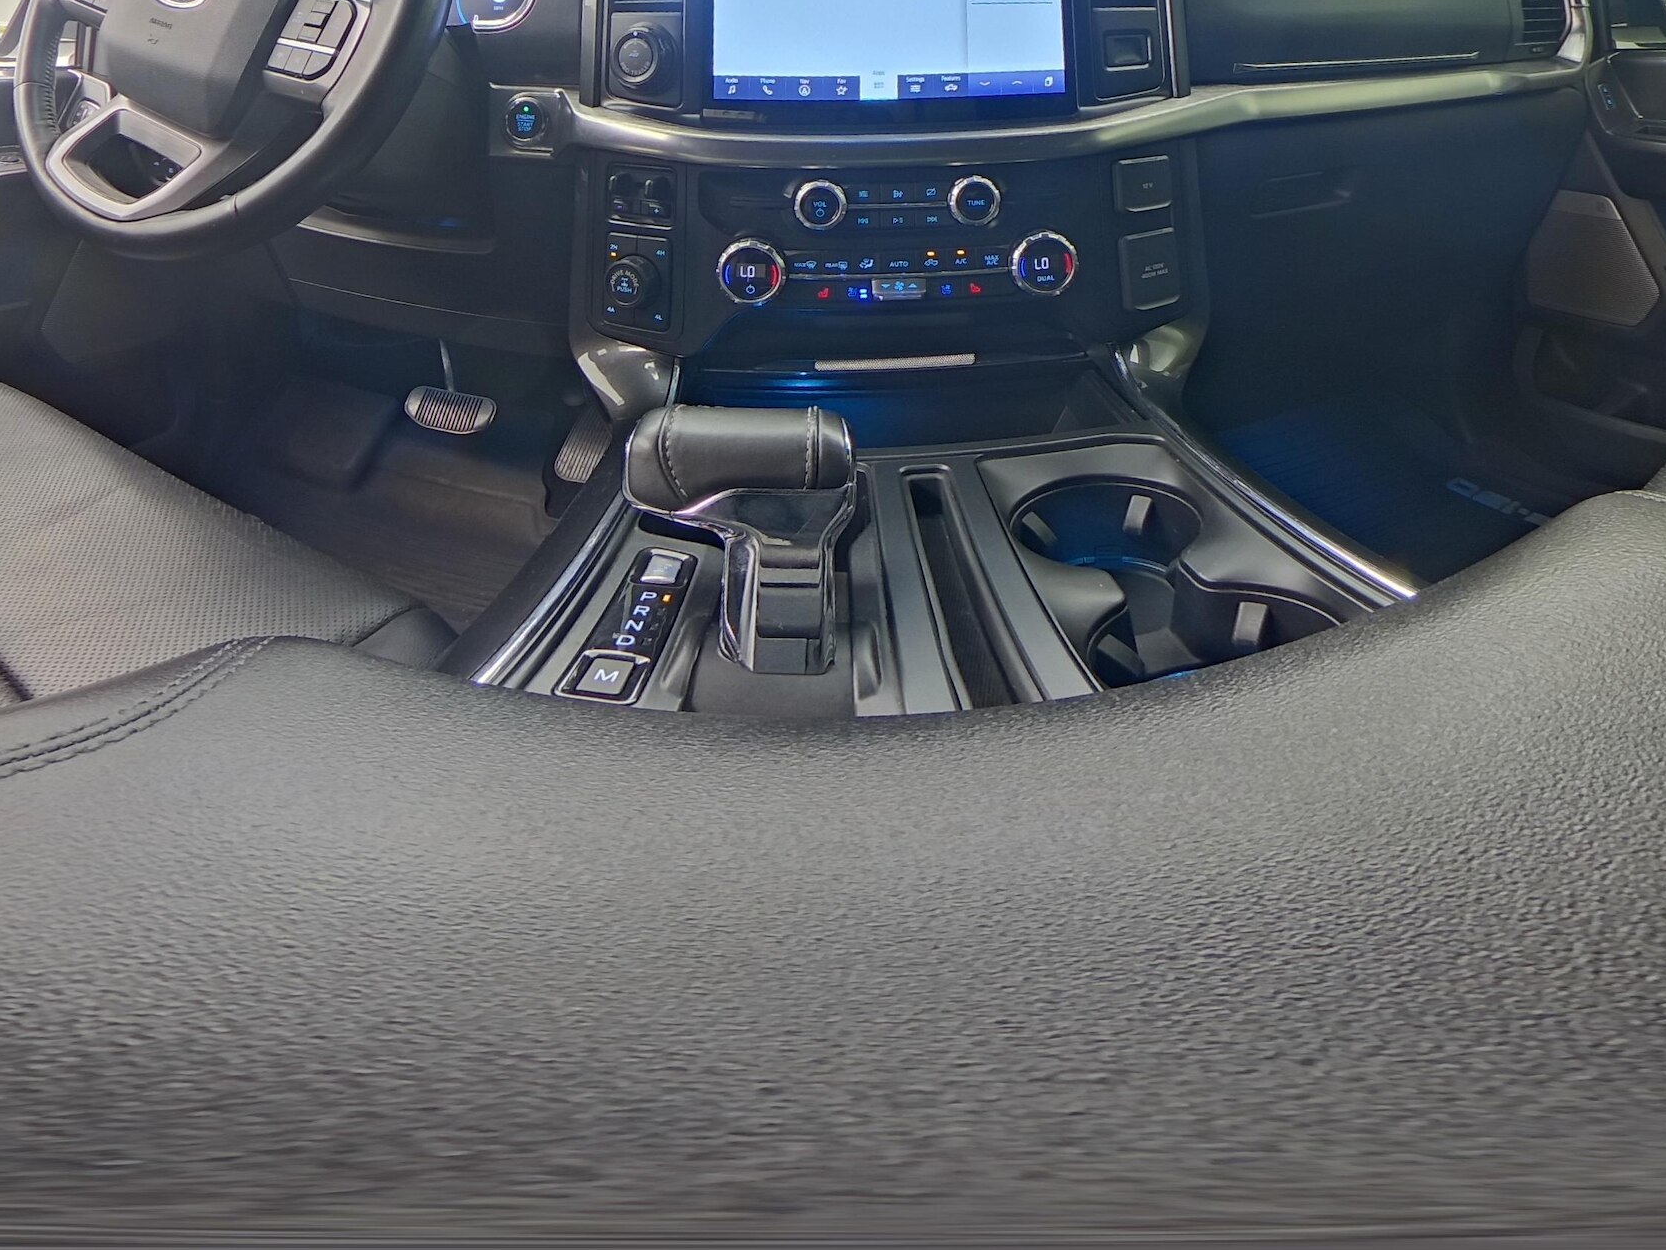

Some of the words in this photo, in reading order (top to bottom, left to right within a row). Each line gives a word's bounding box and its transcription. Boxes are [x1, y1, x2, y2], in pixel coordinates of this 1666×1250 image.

[616, 286, 633, 294] PUSH
[640, 591, 658, 601] P
[633, 605, 651, 616] R
[624, 619, 644, 631] N
[615, 634, 635, 645] D
[593, 668, 620, 682] M
